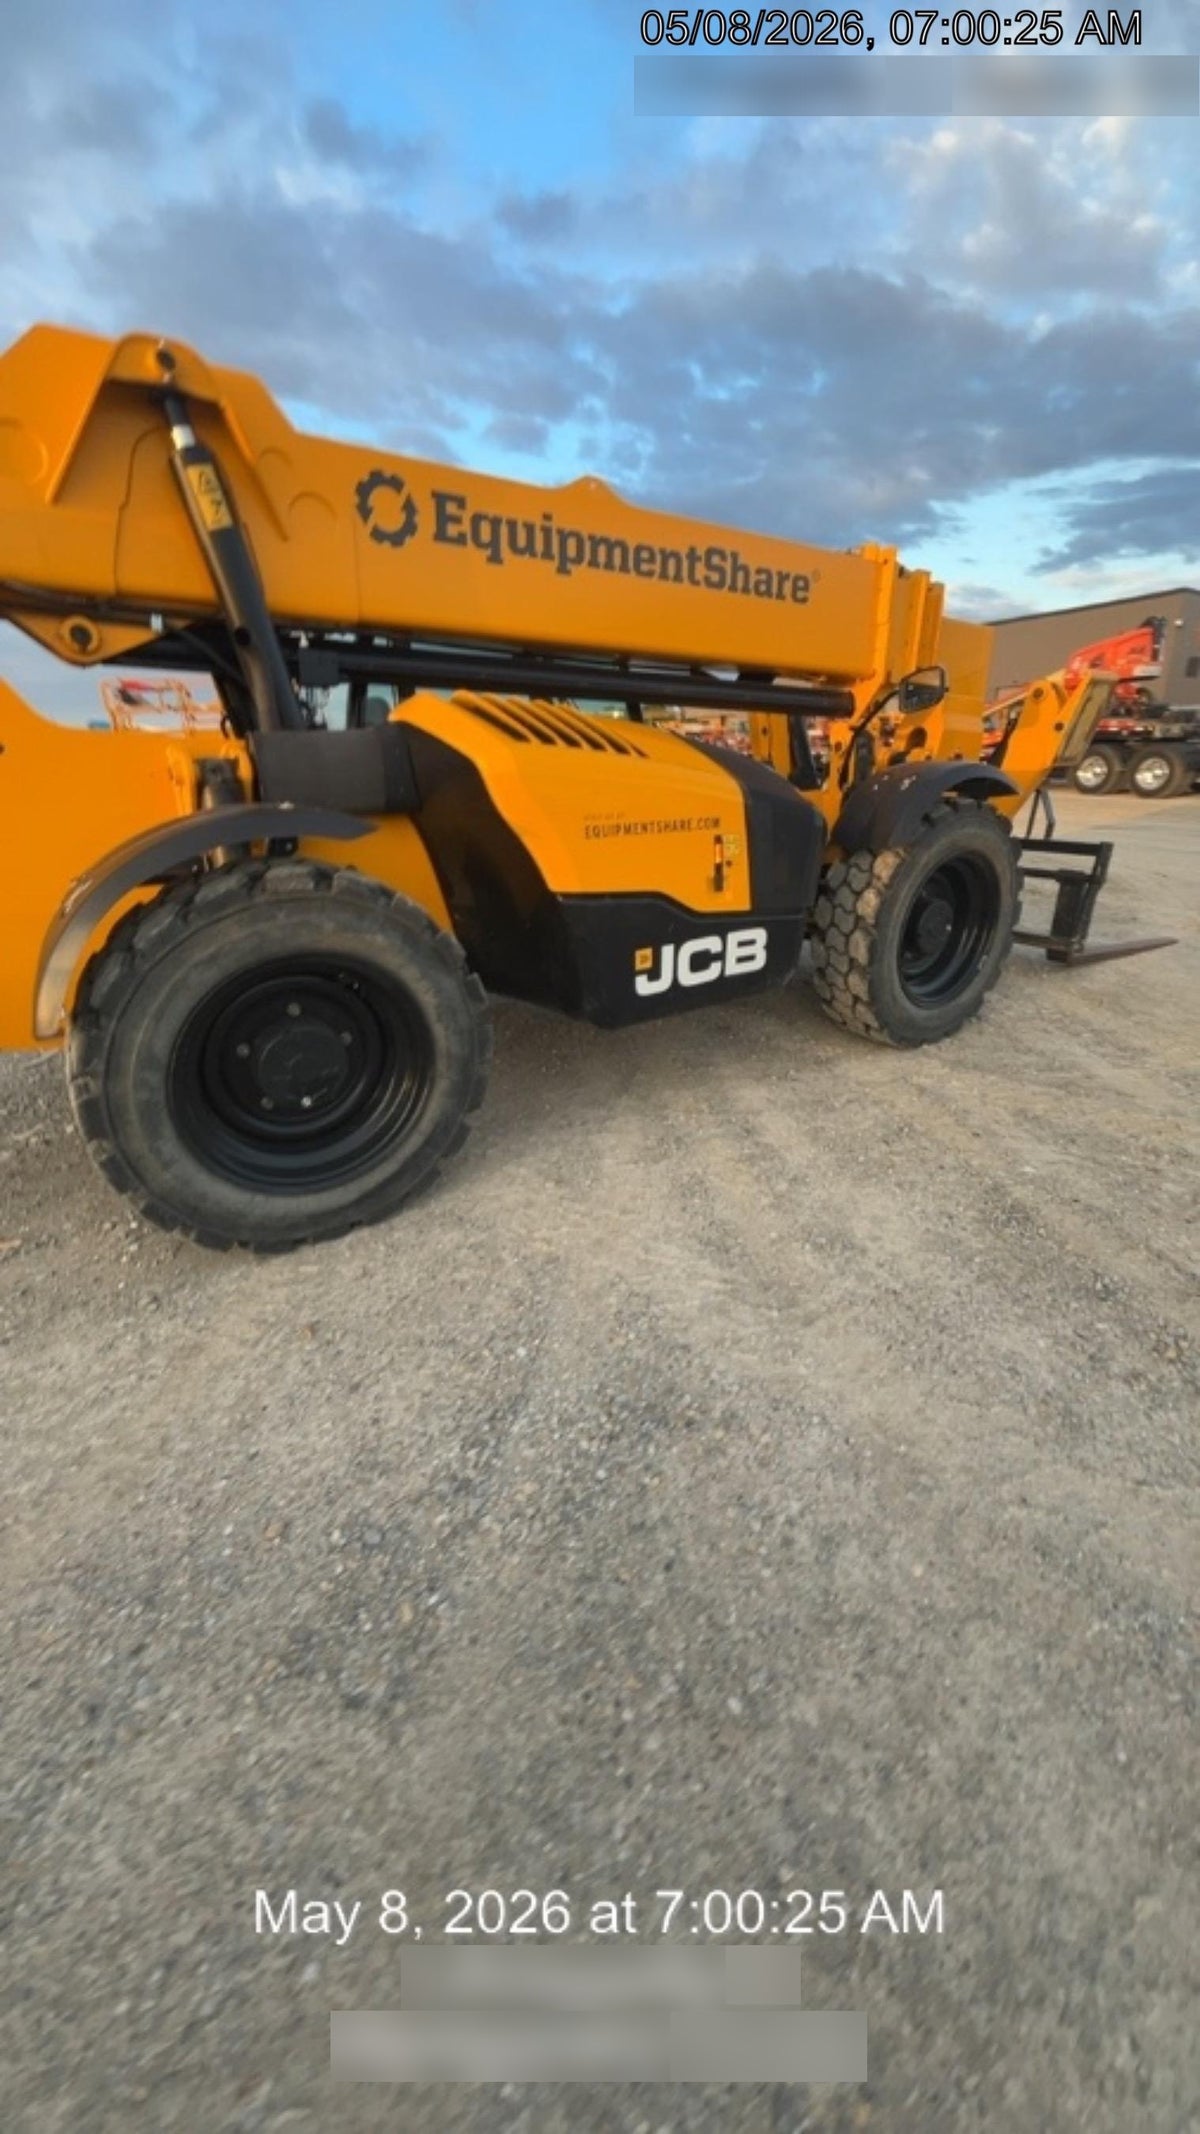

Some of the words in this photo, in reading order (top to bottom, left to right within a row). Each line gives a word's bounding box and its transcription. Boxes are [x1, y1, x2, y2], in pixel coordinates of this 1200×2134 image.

[431, 490, 811, 604] EquipmentShare
[584, 817, 720, 840] EQUIPMENTSHARE.COM
[635, 927, 768, 996] JCB
